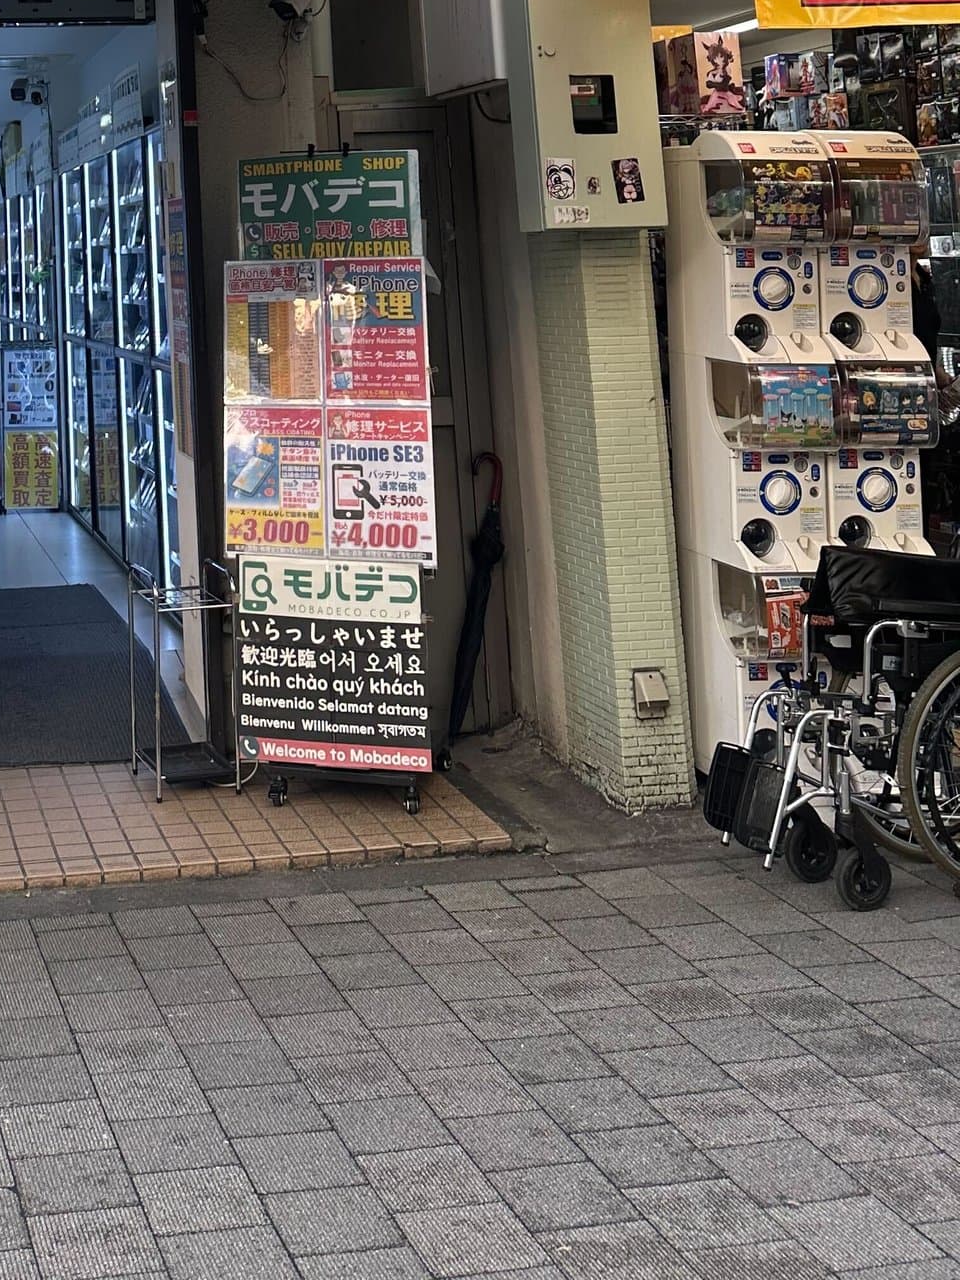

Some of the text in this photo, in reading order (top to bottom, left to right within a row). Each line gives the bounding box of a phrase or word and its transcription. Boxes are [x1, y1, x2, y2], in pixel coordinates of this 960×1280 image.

[243, 157, 406, 177] SMARTPHONE SHOP
[241, 176, 405, 217] モバデコ
[272, 243, 308, 260] SELL
[350, 263, 421, 273] Repair Service
[352, 275, 419, 292] iPhone
[346, 420, 425, 433] 修理サービス
[331, 444, 424, 463] iPhone SE3
[369, 470, 427, 481] バッテリー交換
[283, 564, 418, 605] モバデコ
[288, 604, 411, 619] MOBADECO.CO.JP
[240, 618, 424, 649] いらっしゃいませ
[319, 650, 356, 674] 어서
[364, 652, 426, 677] 오세요
[242, 670, 426, 698] Kính chào quý khách
[242, 693, 429, 720] Bienvenido Selamat datang
[240, 715, 375, 736] Bienvenu Willkommen
[262, 742, 428, 767] Welcome to Mobadeco
